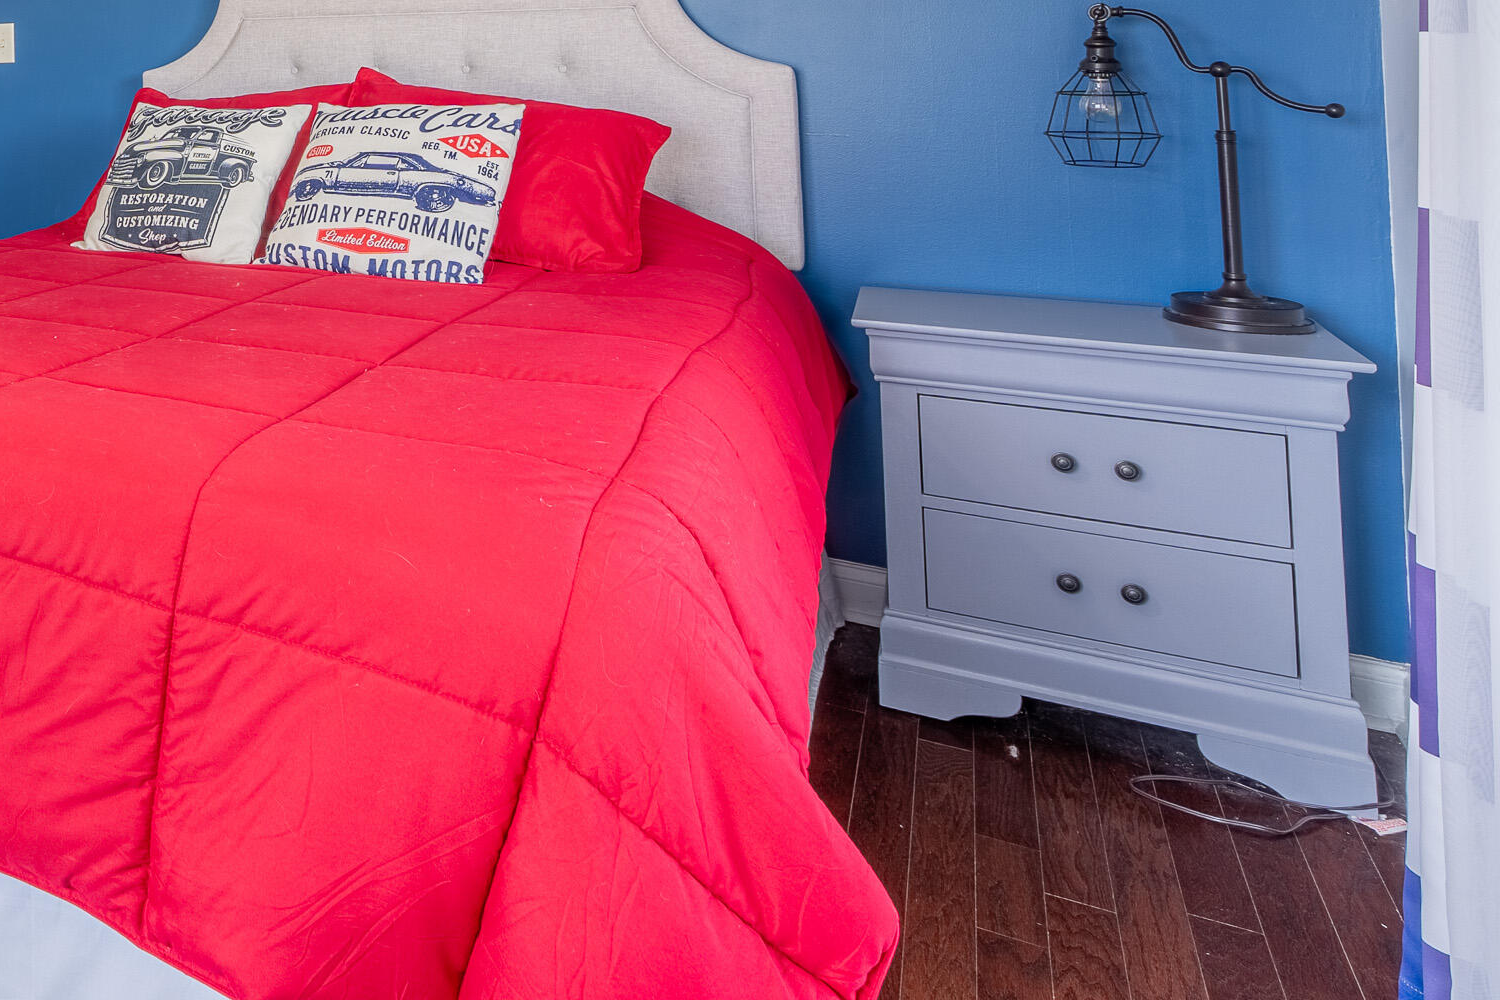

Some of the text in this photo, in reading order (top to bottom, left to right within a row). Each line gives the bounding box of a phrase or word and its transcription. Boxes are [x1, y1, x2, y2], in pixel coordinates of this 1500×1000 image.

[419, 107, 522, 136] Cars
[360, 125, 411, 140] CLASSIC
[223, 144, 256, 157] CUSTOM
[421, 141, 440, 151] REG.
[455, 135, 491, 157] USA
[443, 150, 457, 161] TM.
[325, 170, 334, 179] 71
[477, 165, 498, 181] 1964
[120, 192, 208, 208] RESTORATION
[148, 203, 168, 212] and
[116, 213, 199, 231] CUSTOMIZING
[138, 228, 167, 246] Shop
[321, 229, 406, 251] Limited Edition
[354, 207, 489, 258] PERFORMANCE
[367, 258, 484, 285] MOTORS
